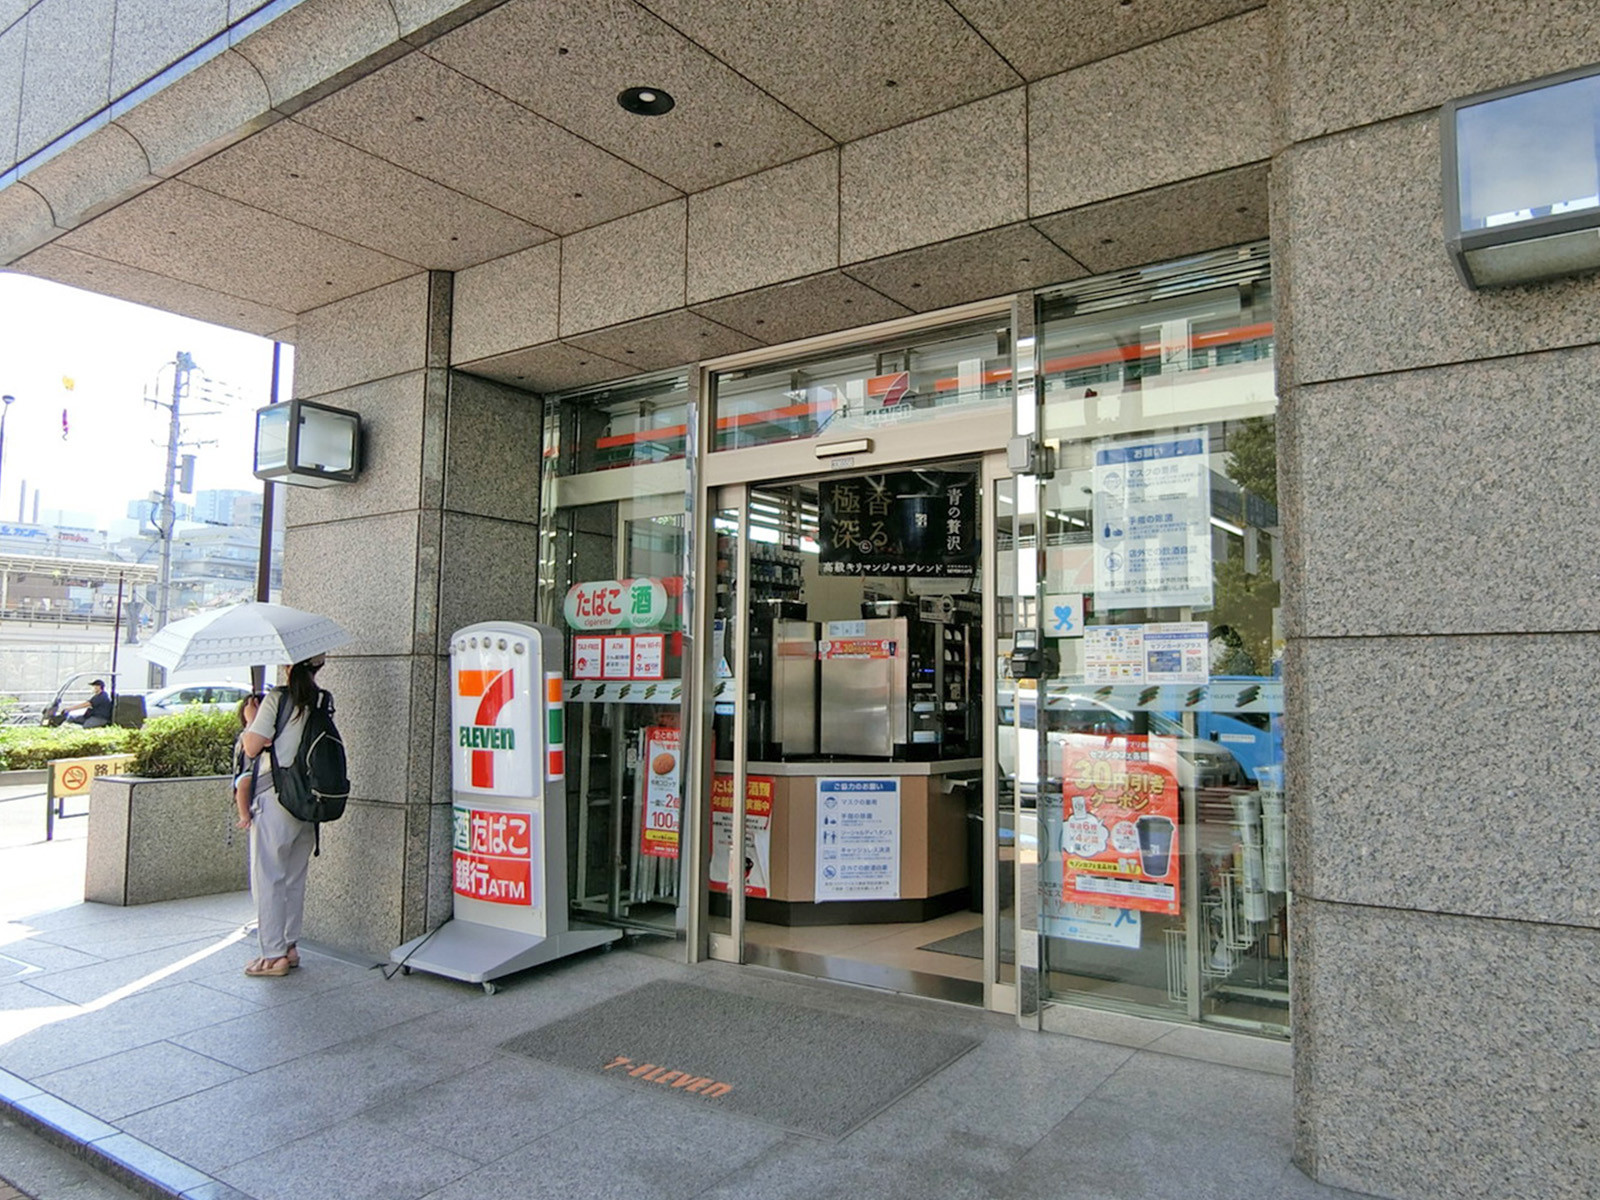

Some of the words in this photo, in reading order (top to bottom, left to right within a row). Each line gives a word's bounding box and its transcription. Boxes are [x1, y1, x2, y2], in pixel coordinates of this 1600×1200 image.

[946, 488, 963, 551] 青の贅沢
[823, 561, 943, 574] 高級キリマンジャロブレンド
[576, 588, 622, 617] たばこ
[630, 585, 652, 614] 酒
[458, 668, 514, 789] 7
[833, 782, 884, 791] ご協力のお願い
[1074, 760, 1165, 795] 30円引き
[1090, 791, 1150, 812] クーポン
[472, 814, 528, 855] たばこ
